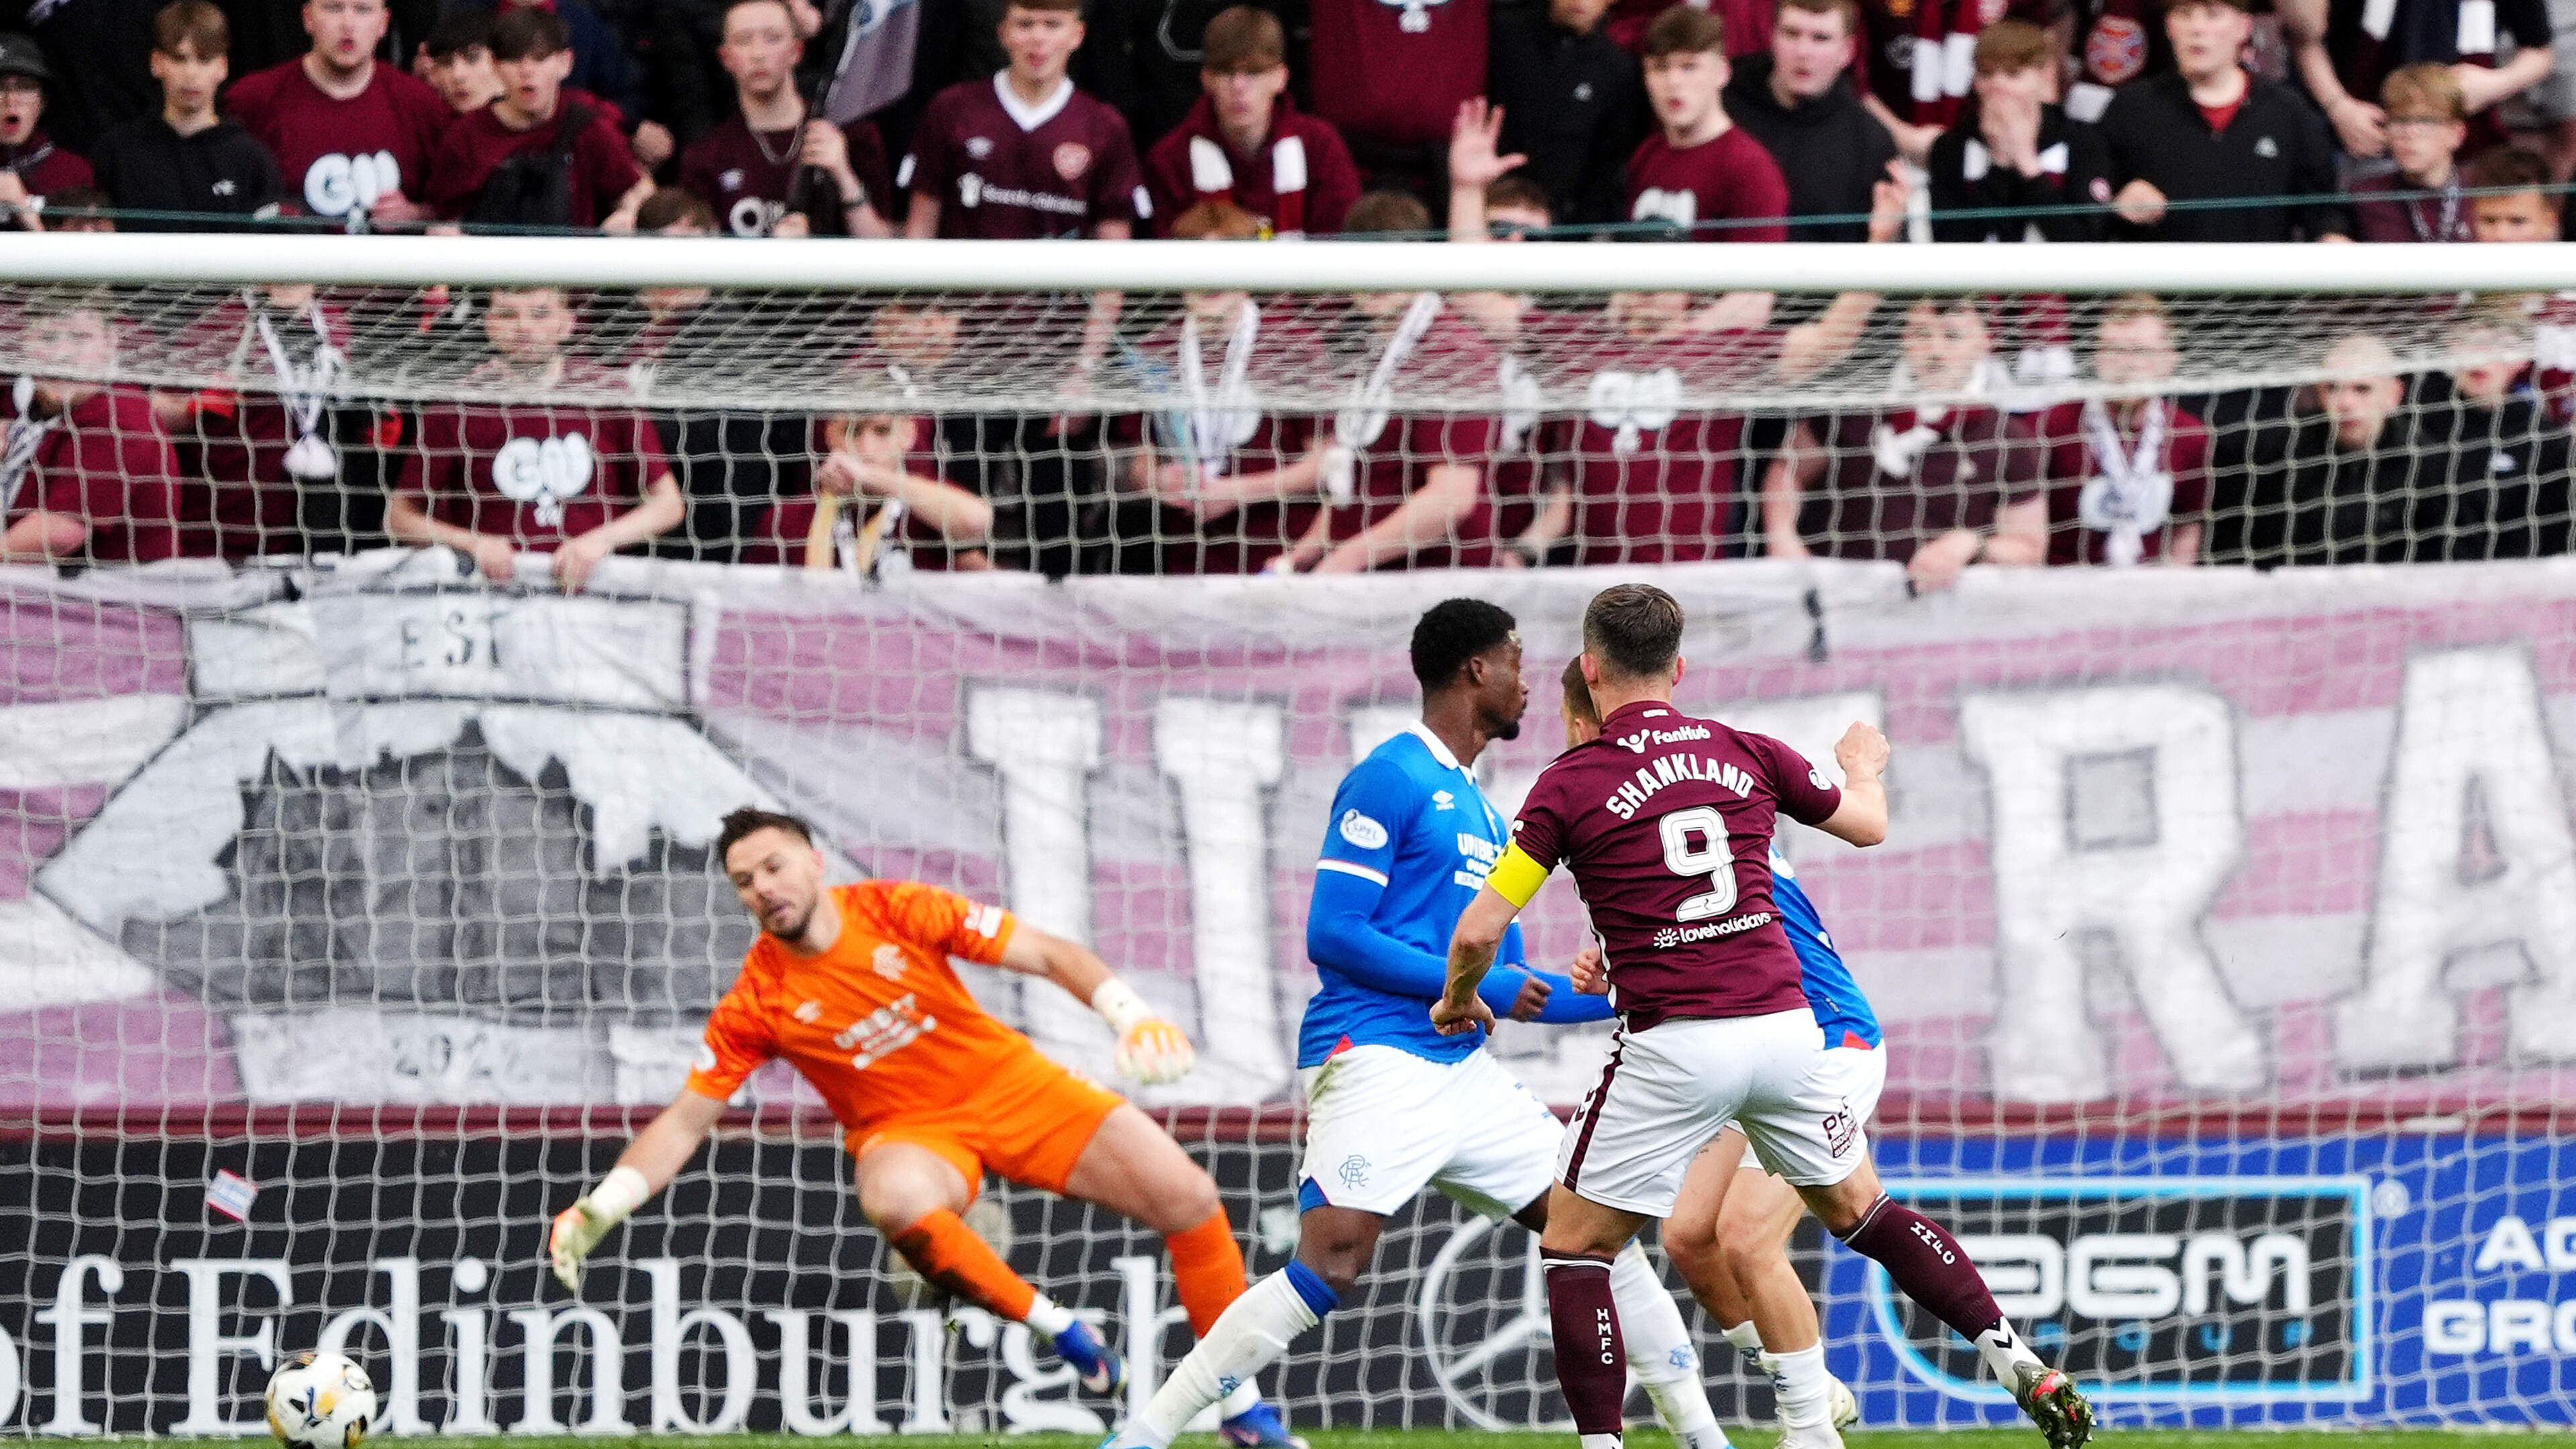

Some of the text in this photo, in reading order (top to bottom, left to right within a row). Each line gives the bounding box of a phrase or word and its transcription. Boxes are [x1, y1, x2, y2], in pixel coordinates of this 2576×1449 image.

[1652, 724, 1711, 745] FanHub
[1605, 753, 1754, 820] SHANKLAND
[1659, 806, 1738, 922] 9
[1679, 912, 1772, 943] loveholidays
[1910, 1221, 1955, 1265] HMFC
[1596, 1308, 1614, 1365] HMFC
